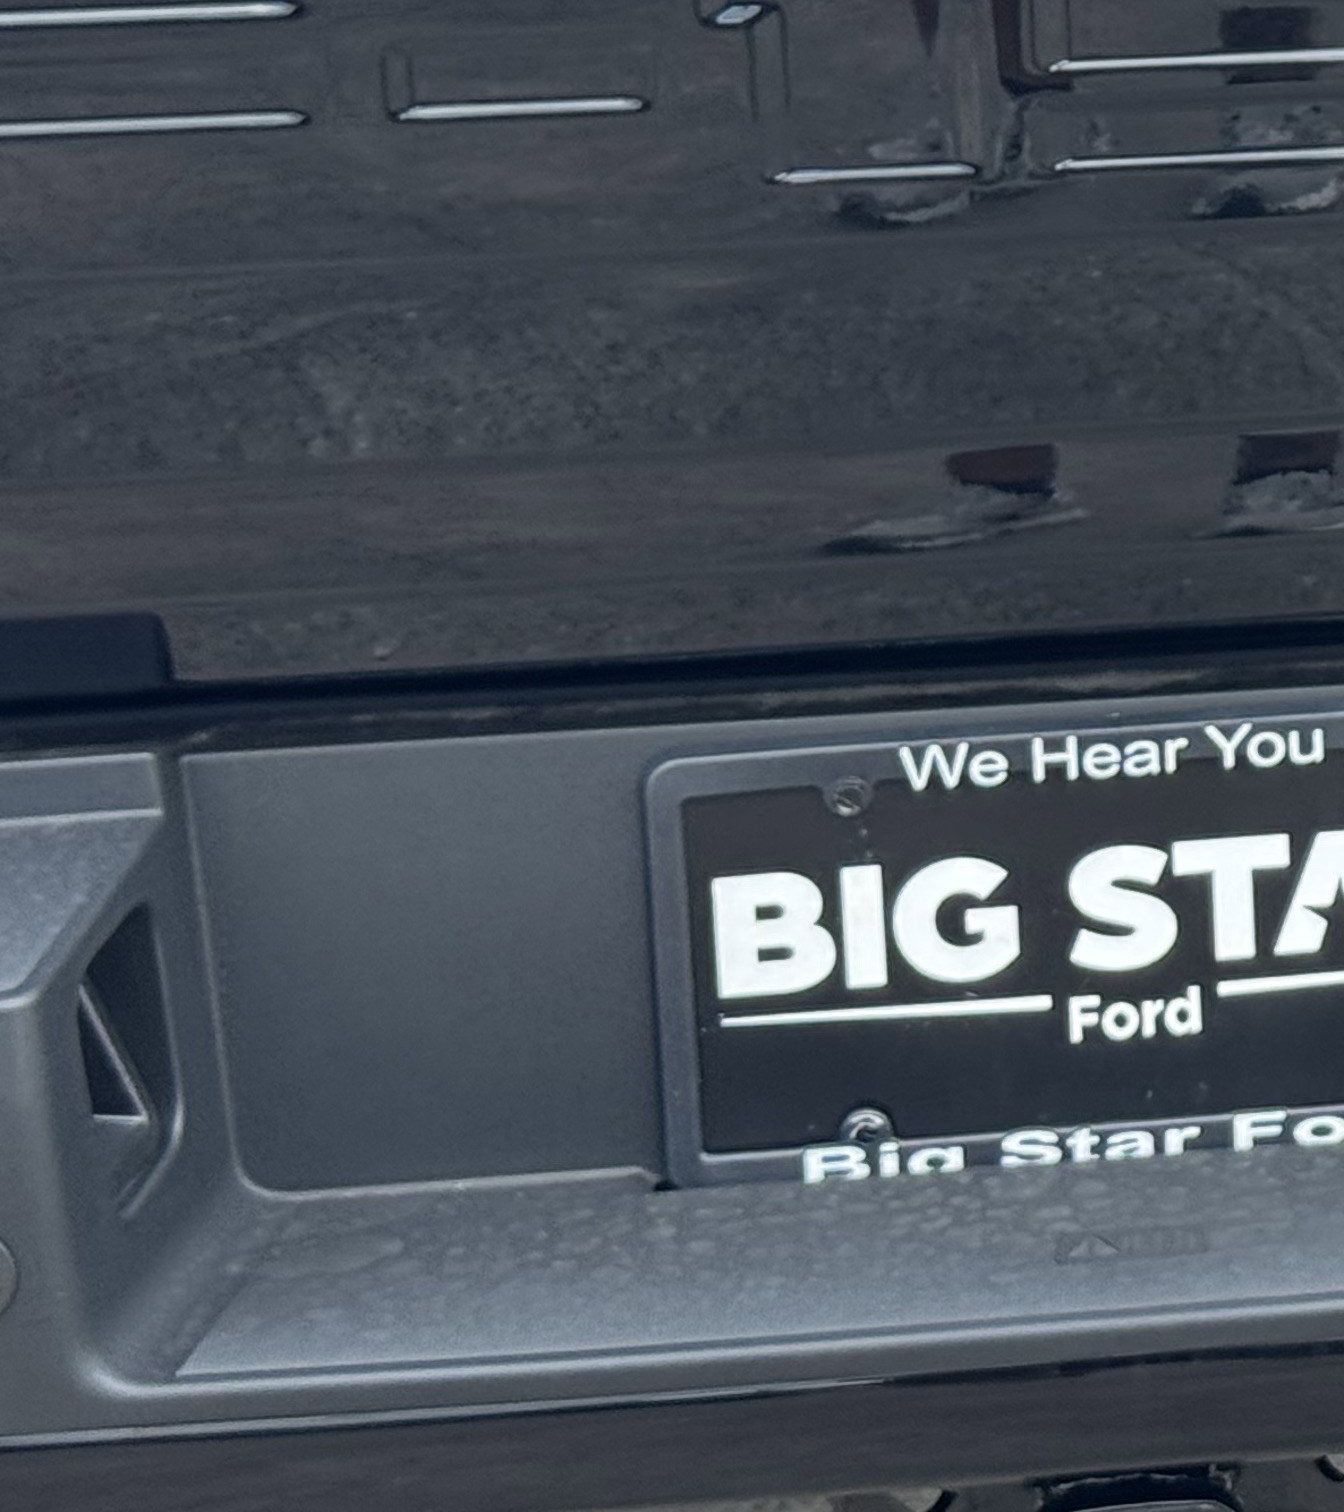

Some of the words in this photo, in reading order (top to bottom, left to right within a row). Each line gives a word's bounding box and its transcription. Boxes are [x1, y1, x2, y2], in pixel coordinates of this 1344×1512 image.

[898, 740, 1009, 792] We
[1031, 734, 1189, 784] Hear
[1204, 722, 1325, 771] You
[711, 856, 1021, 999] BIG
[1068, 984, 1203, 1044] Ford
[1000, 1126, 1201, 1168] Star
